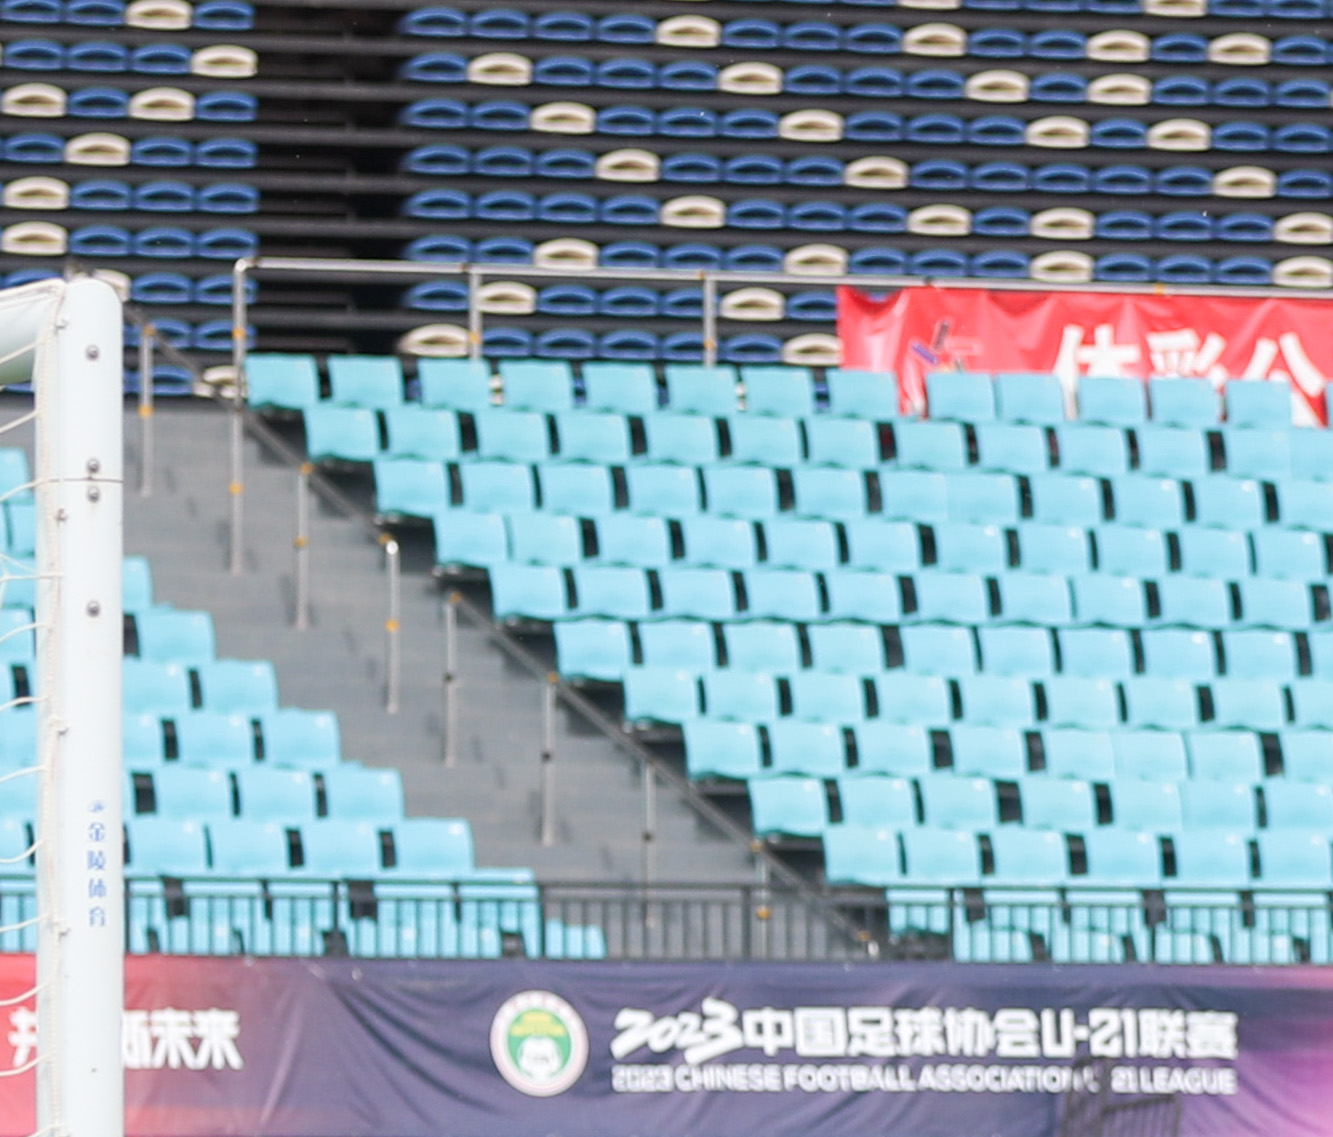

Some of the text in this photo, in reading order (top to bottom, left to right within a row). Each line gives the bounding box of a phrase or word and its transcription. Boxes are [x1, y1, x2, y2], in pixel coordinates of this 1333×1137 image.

[674, 1063, 783, 1092] CHINESE
[783, 1064, 916, 1092] FOOTBALL
[1140, 1066, 1238, 1095] LEAGUE
